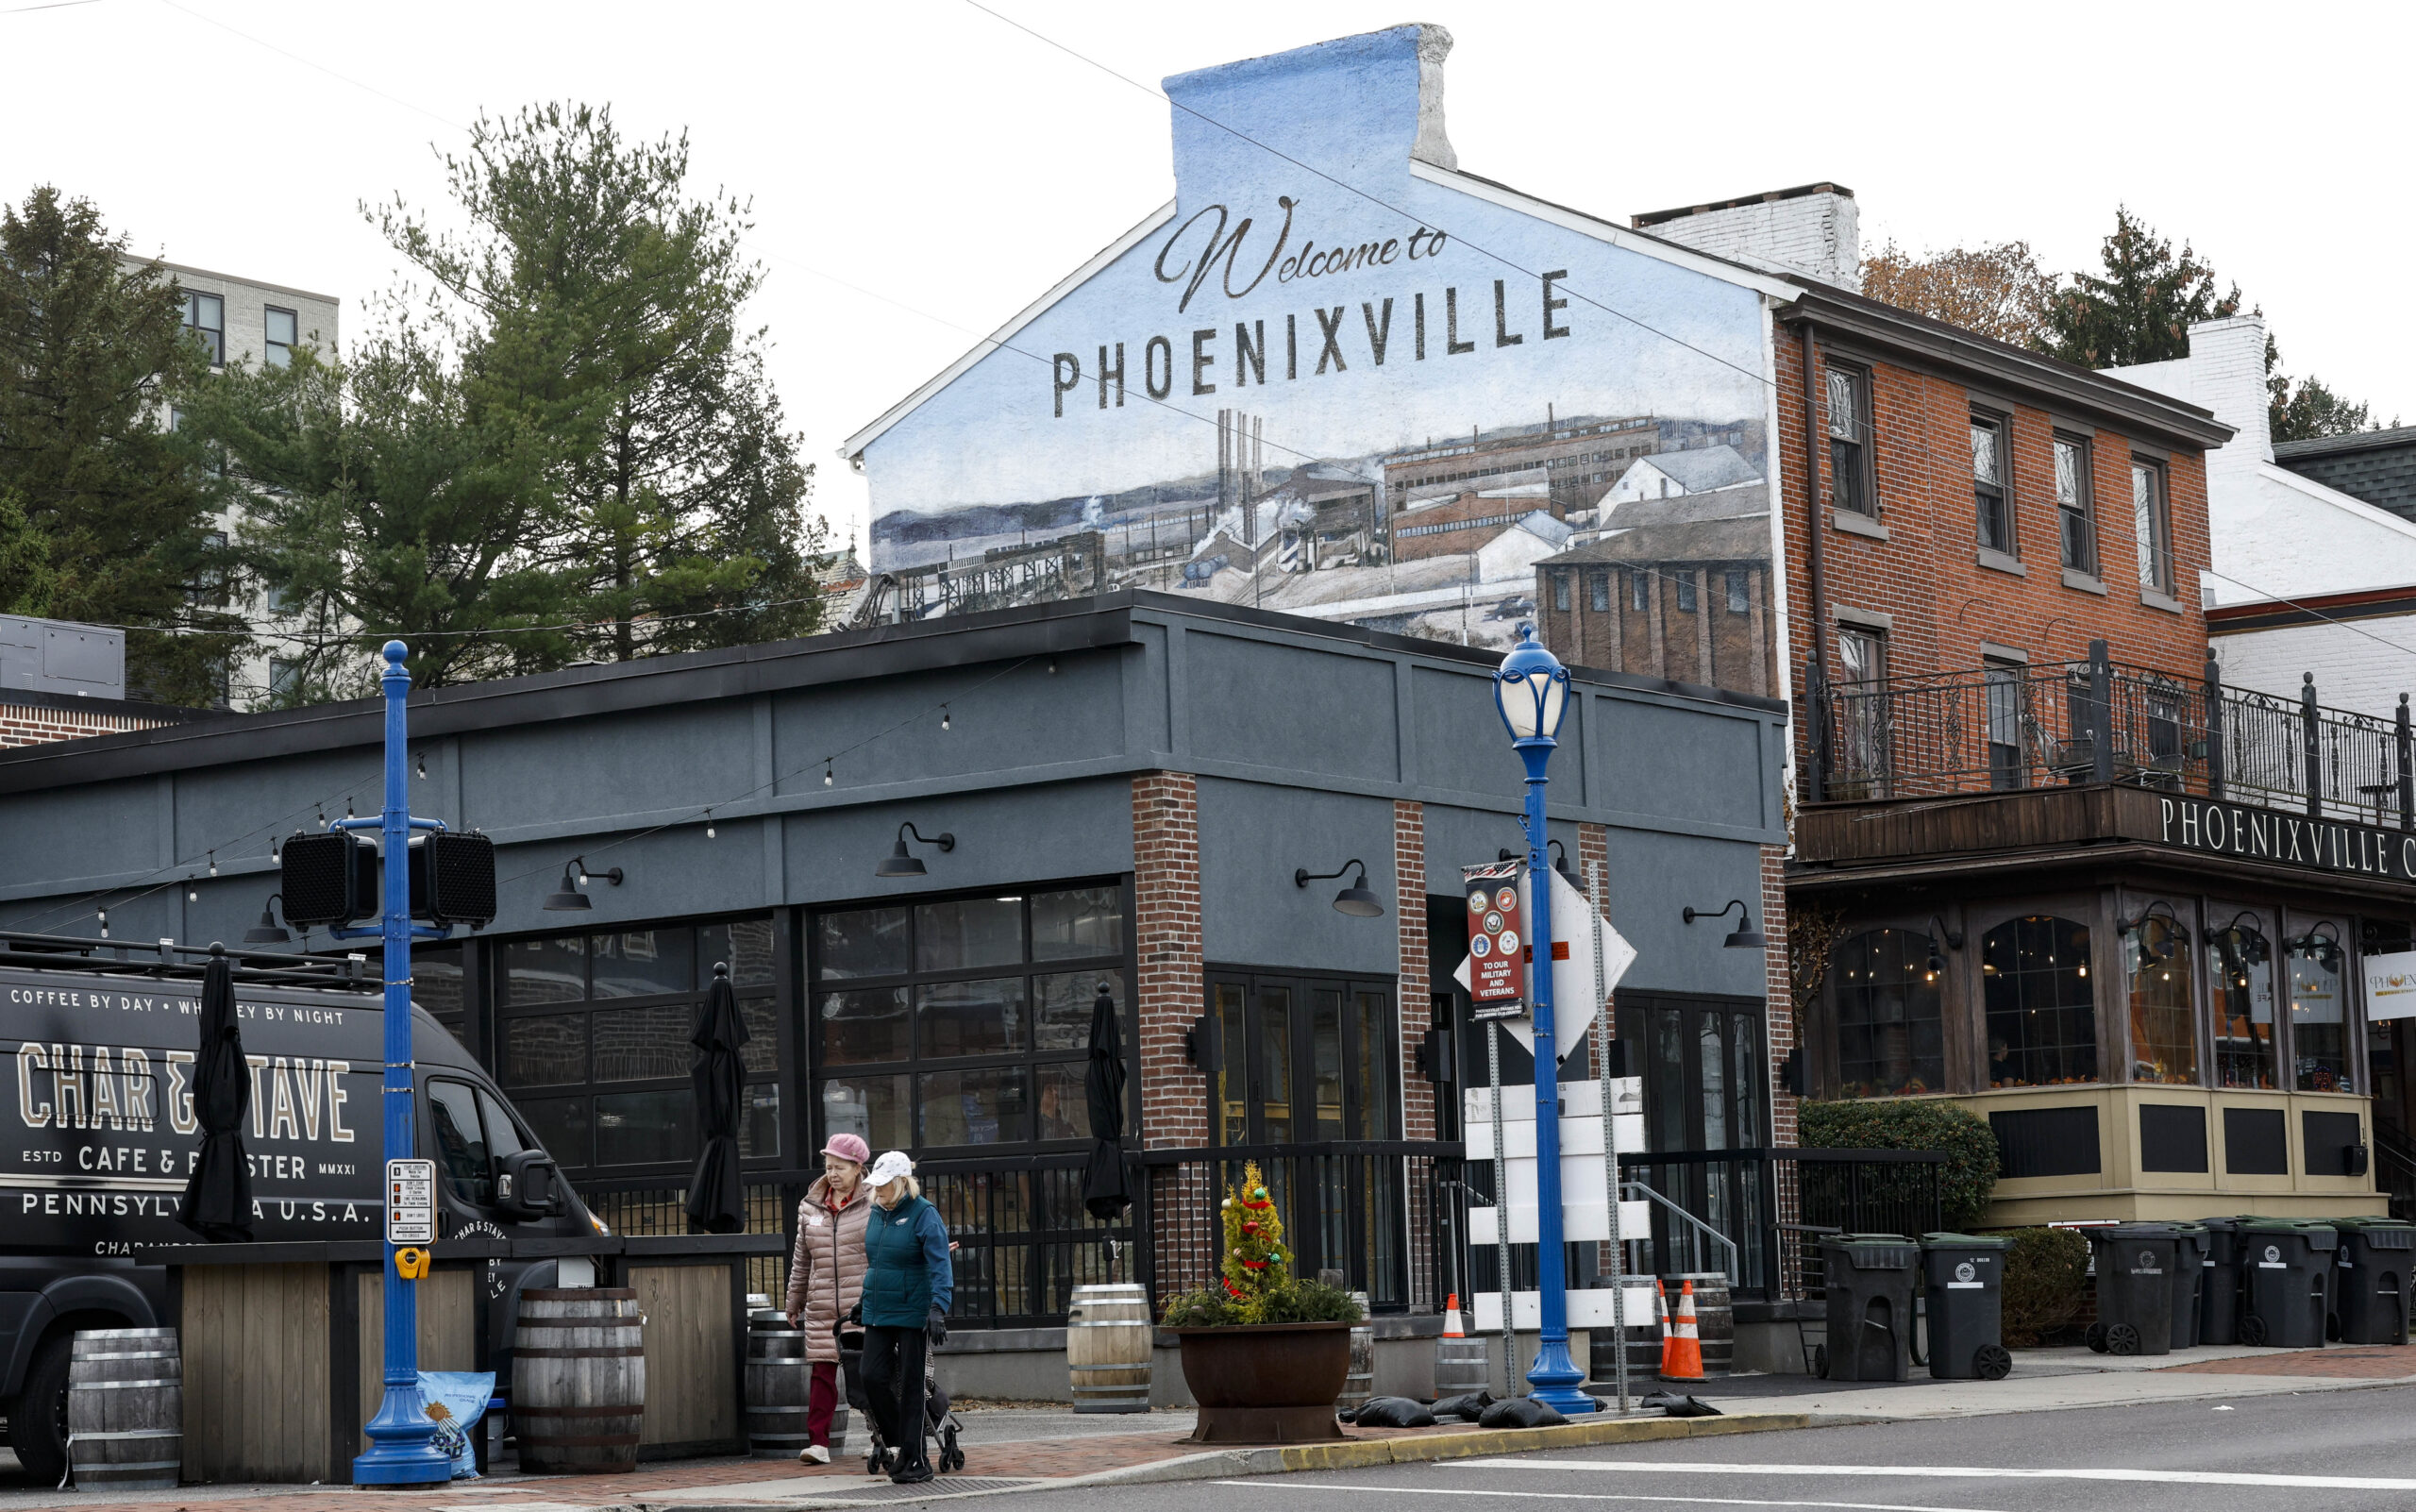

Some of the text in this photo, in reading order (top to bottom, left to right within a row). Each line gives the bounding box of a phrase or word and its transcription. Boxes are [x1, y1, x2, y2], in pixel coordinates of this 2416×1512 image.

[1154, 195, 1448, 313] Welcome to
[1053, 269, 1570, 418] PHOENIXVILLE
[2160, 798, 2388, 873] PHOENIXVILLE
[1481, 969, 1511, 979] MILITARY
[1483, 962, 1492, 970] TO
[1480, 987, 1515, 997] VETERANS
[10, 989, 344, 1026] COFFEE BY DAY WHEY BY NIGHT
[17, 1042, 355, 1143] CHAR & TAVE
[23, 1150, 62, 1163] ESTD
[78, 1146, 147, 1172] CAFE
[159, 1150, 175, 1173] &
[319, 1163, 356, 1176] MMXXI
[280, 1201, 370, 1223] U.S.A.
[476, 1220, 481, 1231] &
[483, 1221, 506, 1239] STAV
